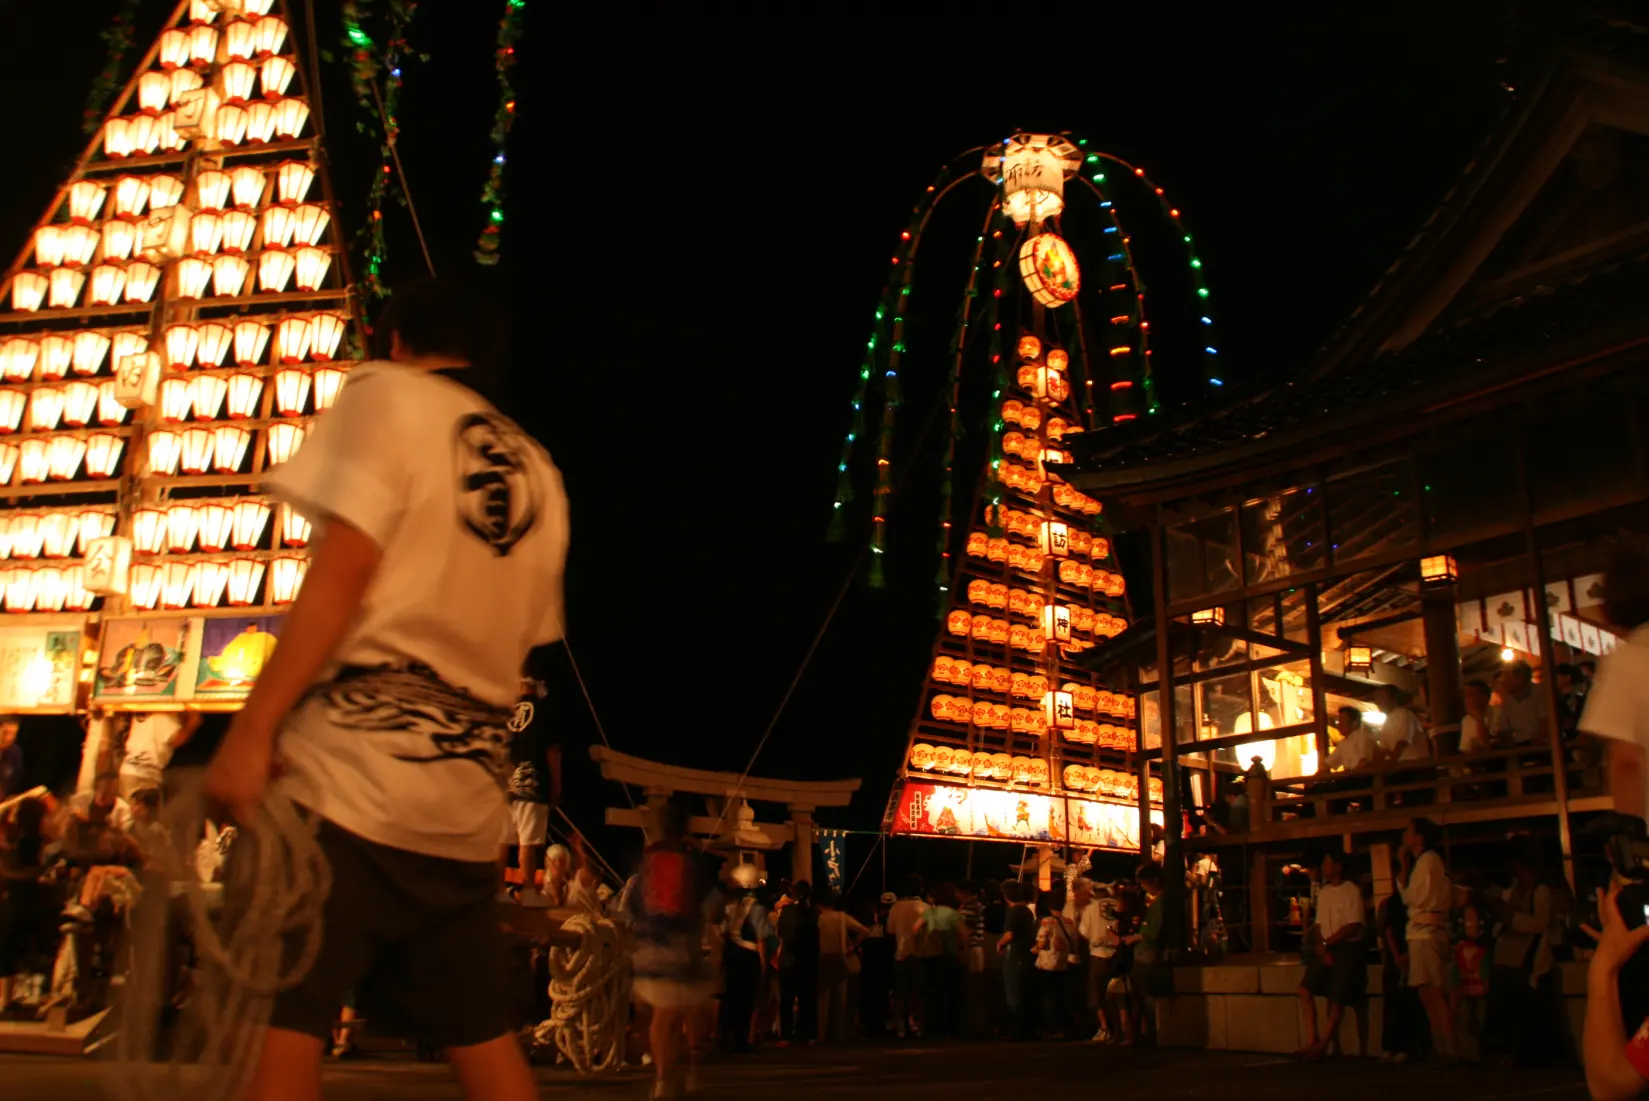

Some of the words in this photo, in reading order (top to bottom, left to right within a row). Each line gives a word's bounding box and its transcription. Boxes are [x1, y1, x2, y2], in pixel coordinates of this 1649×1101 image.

[1052, 532, 1068, 550] 訪
[1056, 615, 1070, 634] 神
[1057, 699, 1072, 719] 社
